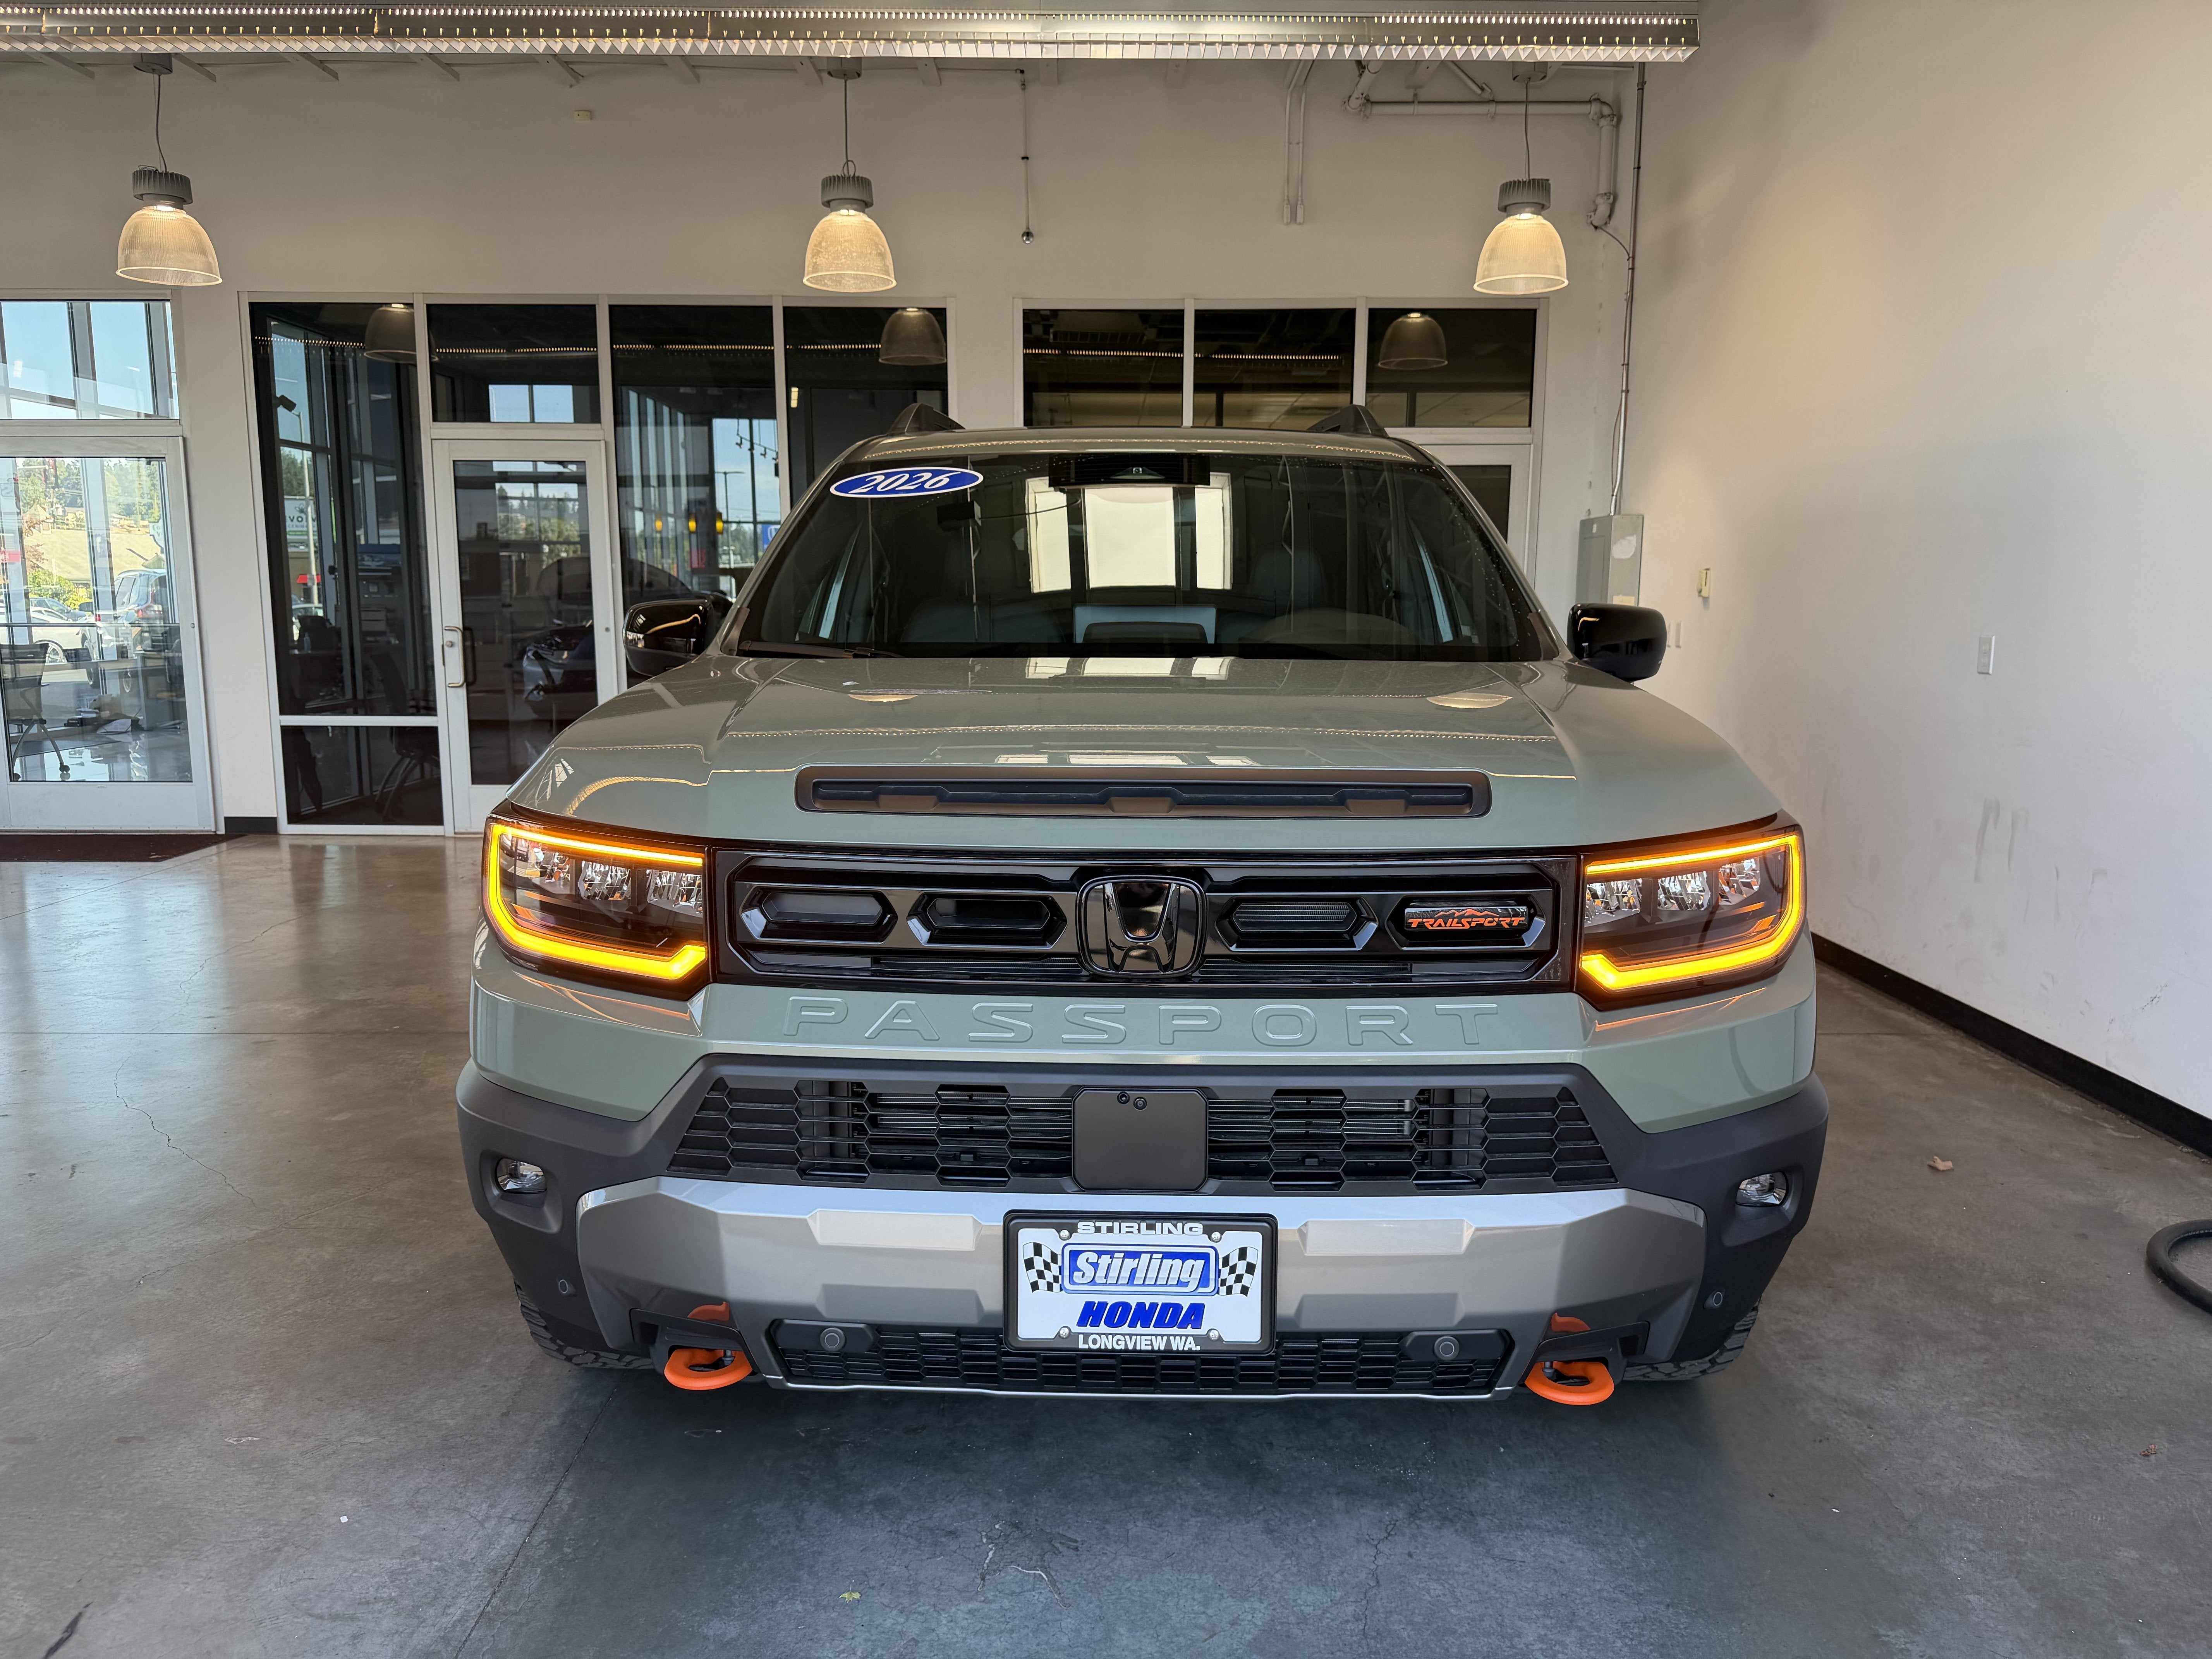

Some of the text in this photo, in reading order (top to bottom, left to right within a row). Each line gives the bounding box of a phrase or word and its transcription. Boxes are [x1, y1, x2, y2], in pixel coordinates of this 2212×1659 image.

[848, 472, 961, 494] 2026
[1408, 917, 1525, 929] TRAILSPORT
[783, 996, 1498, 1045] PASSPORT
[1077, 1221, 1203, 1235] STIRLING
[1073, 1252, 1205, 1292] Stirling
[1077, 1301, 1205, 1329] HONDA
[1079, 1334, 1200, 1351] LONGVIEW WA.
